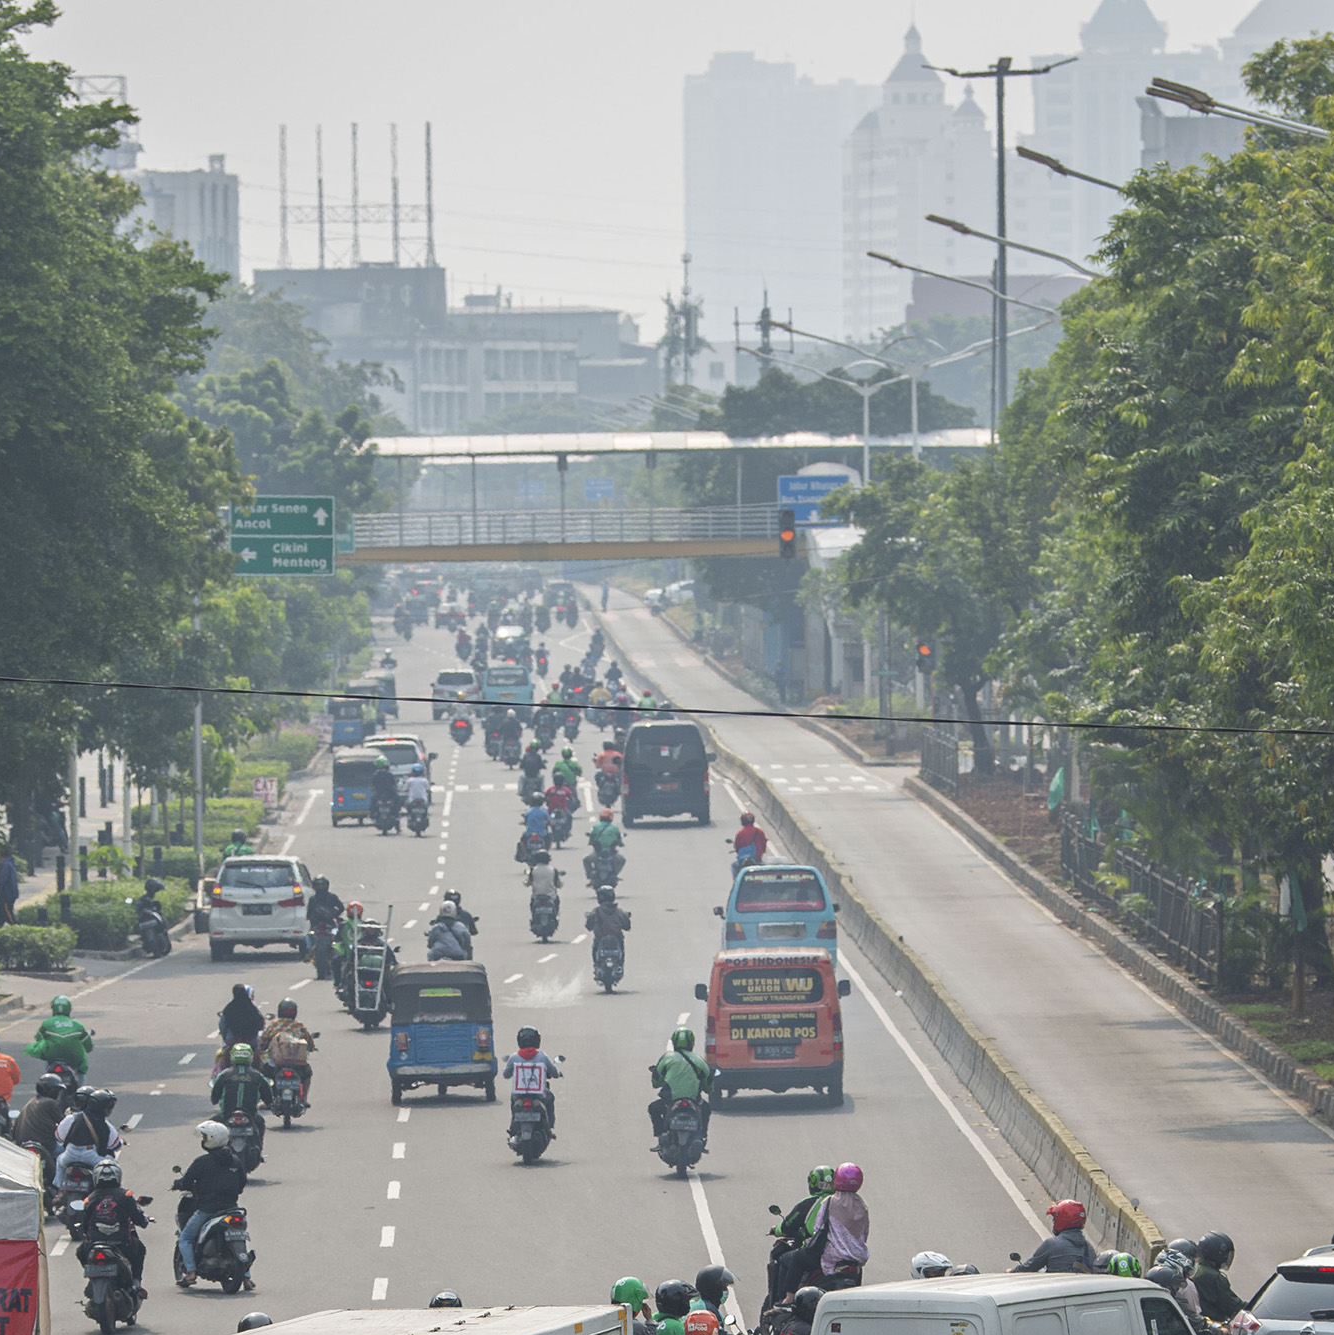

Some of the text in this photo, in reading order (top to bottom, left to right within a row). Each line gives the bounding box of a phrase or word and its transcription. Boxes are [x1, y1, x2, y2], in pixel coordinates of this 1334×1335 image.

[271, 502, 308, 514] Senen
[235, 518, 272, 530] Ancol
[272, 542, 308, 554] Cikini
[272, 556, 328, 571] Menteng
[725, 956, 819, 967] POS INDONESIA
[732, 977, 813, 991] WESTERN WU
[747, 984, 781, 993] UNION
[731, 1027, 817, 1040] DI KANTOR POS
